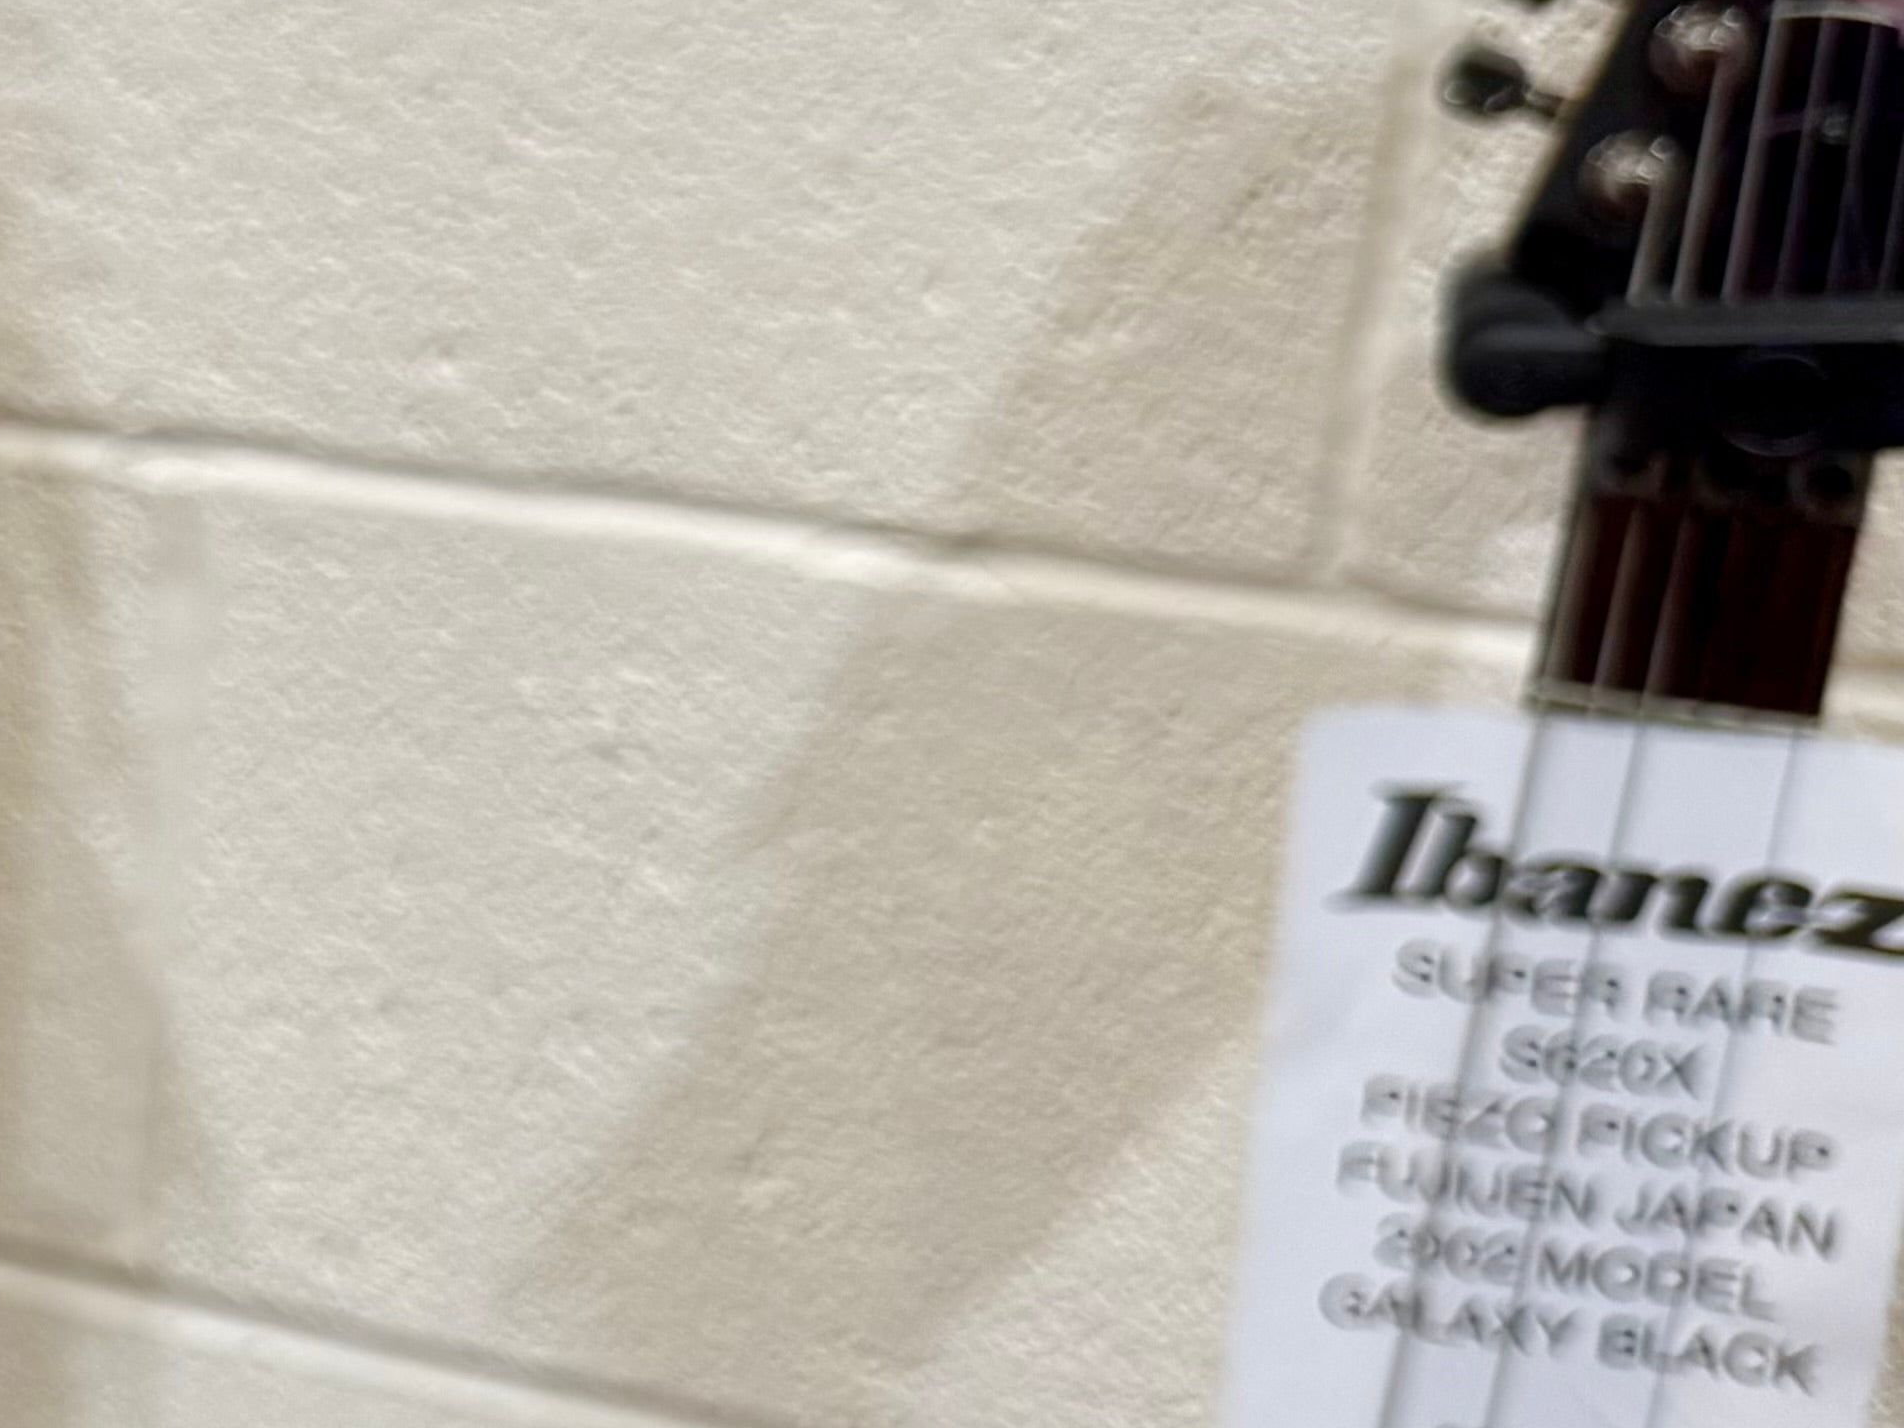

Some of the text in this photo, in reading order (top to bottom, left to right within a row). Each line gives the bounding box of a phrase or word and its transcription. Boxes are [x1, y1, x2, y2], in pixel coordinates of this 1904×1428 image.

[1330, 782, 1904, 960] Ibanez
[1392, 938, 1840, 1046] SUPER RARE
[1359, 1074, 1840, 1176] PIEZO PICKUP
[1616, 1188, 1840, 1260] JAPAN
[1318, 1274, 1820, 1394] GALAXY BLACK
[1533, 1242, 1779, 1322] MODEL
